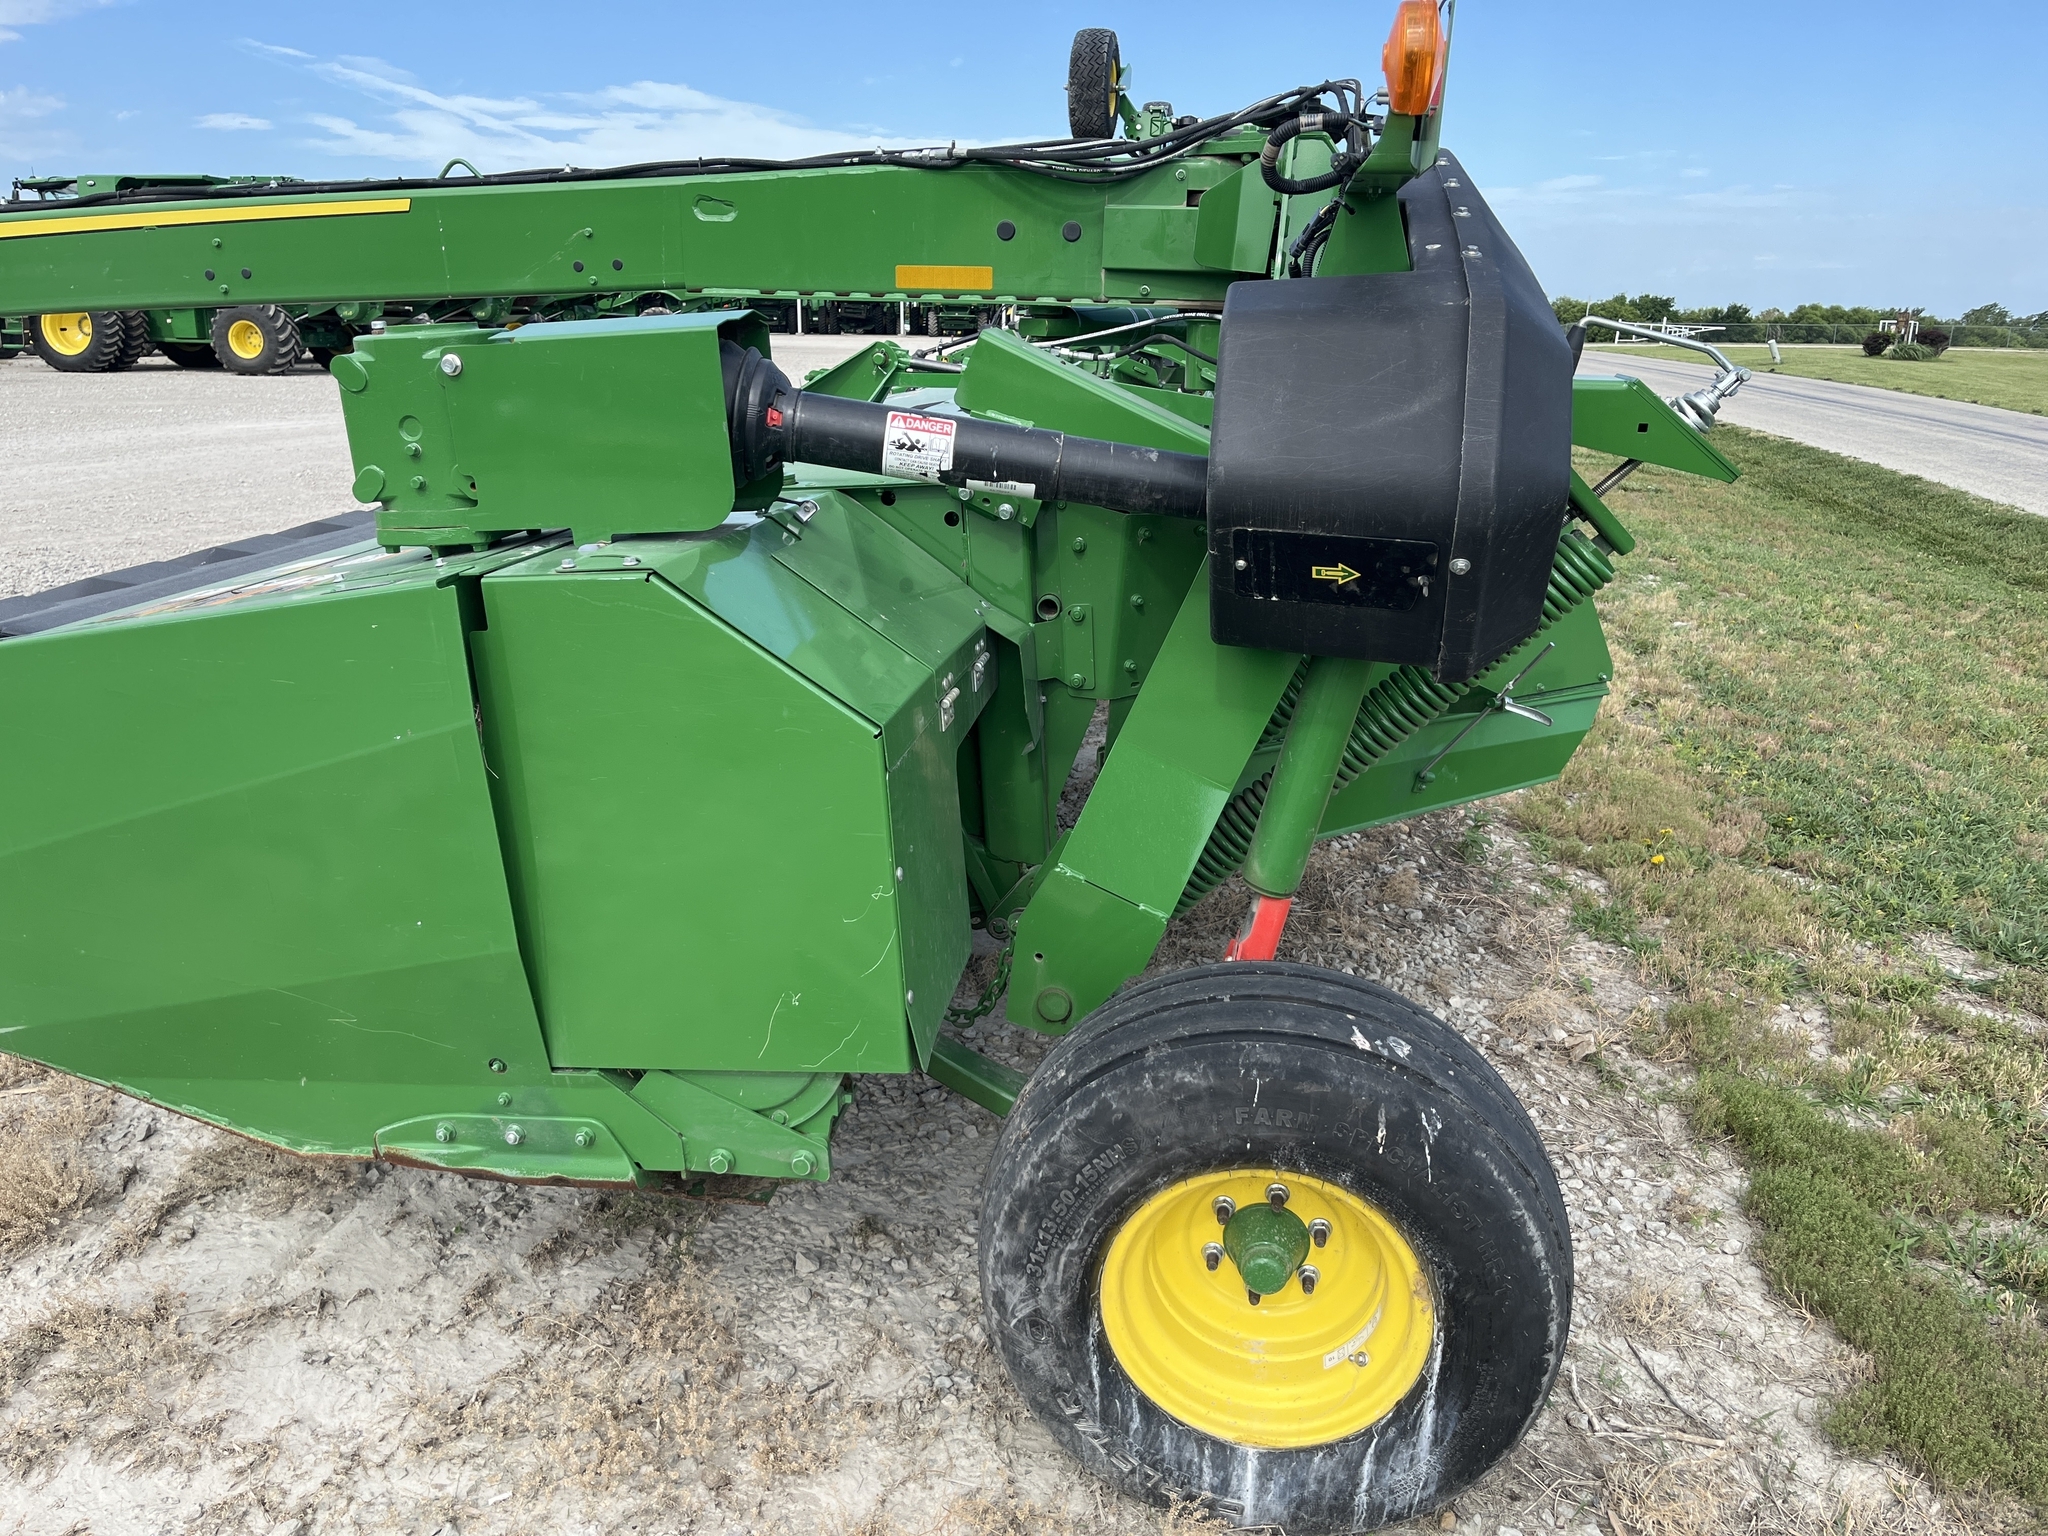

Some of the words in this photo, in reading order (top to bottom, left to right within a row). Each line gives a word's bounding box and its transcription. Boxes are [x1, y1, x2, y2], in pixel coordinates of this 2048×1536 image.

[906, 418, 952, 434] DANGER
[889, 451, 914, 459] ROTATING
[930, 456, 947, 464] SHAFT
[1235, 1106, 1319, 1132] FARM
[1065, 1195, 1087, 1220] HIGHWAY
[1086, 1174, 1109, 1196] SERVICE
